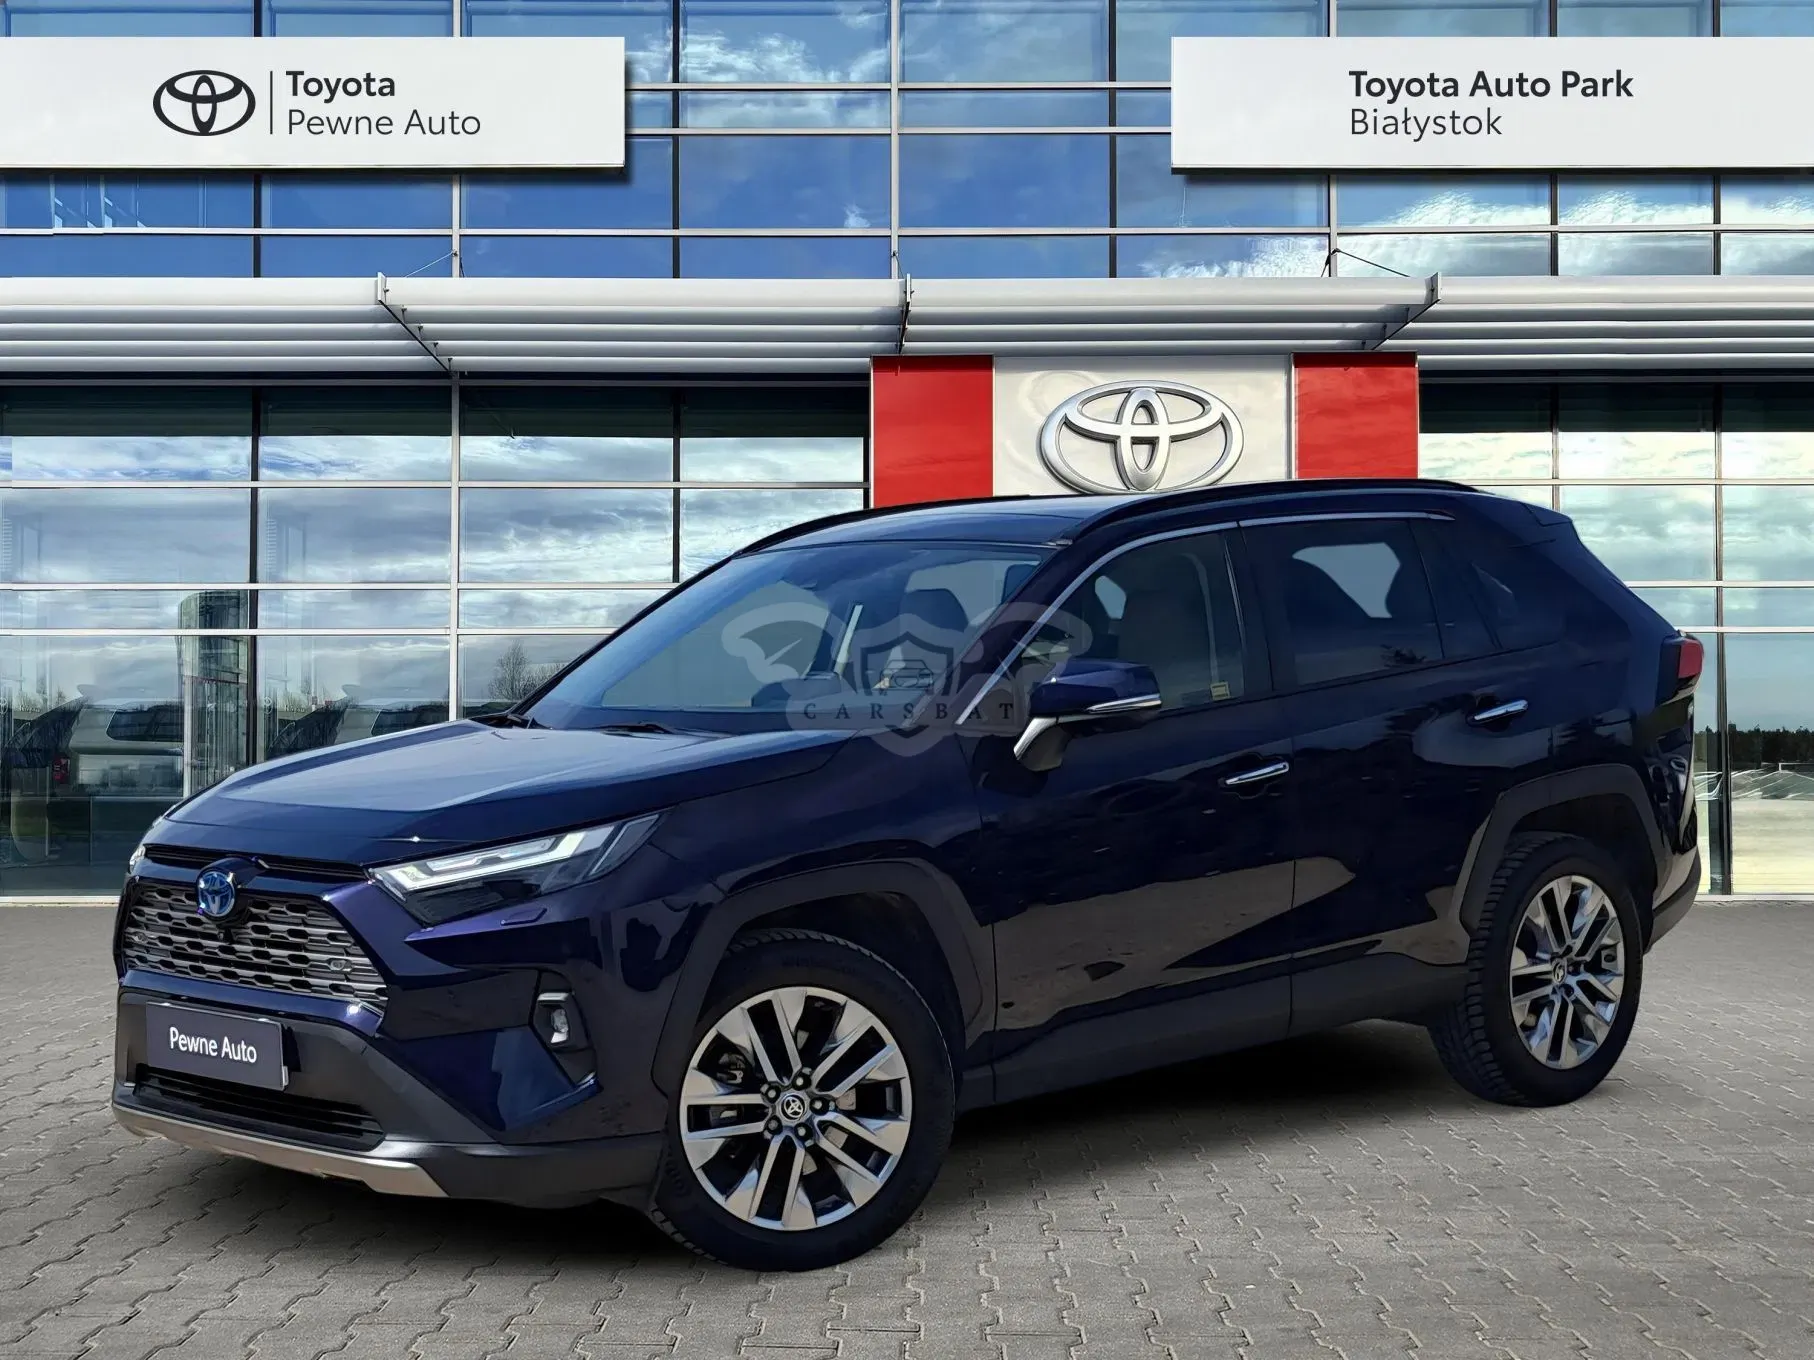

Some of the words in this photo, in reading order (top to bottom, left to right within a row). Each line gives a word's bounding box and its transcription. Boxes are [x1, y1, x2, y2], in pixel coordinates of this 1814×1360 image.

[285, 70, 397, 105] Toyota
[1348, 70, 1460, 105] Toyota
[1468, 70, 1551, 98] Auto
[1561, 69, 1634, 97] Park
[288, 108, 395, 136] Pewne
[403, 108, 482, 136] Auto
[1351, 106, 1503, 143] Białystok
[169, 1026, 218, 1057] Pewne
[220, 1036, 258, 1063] Auto
